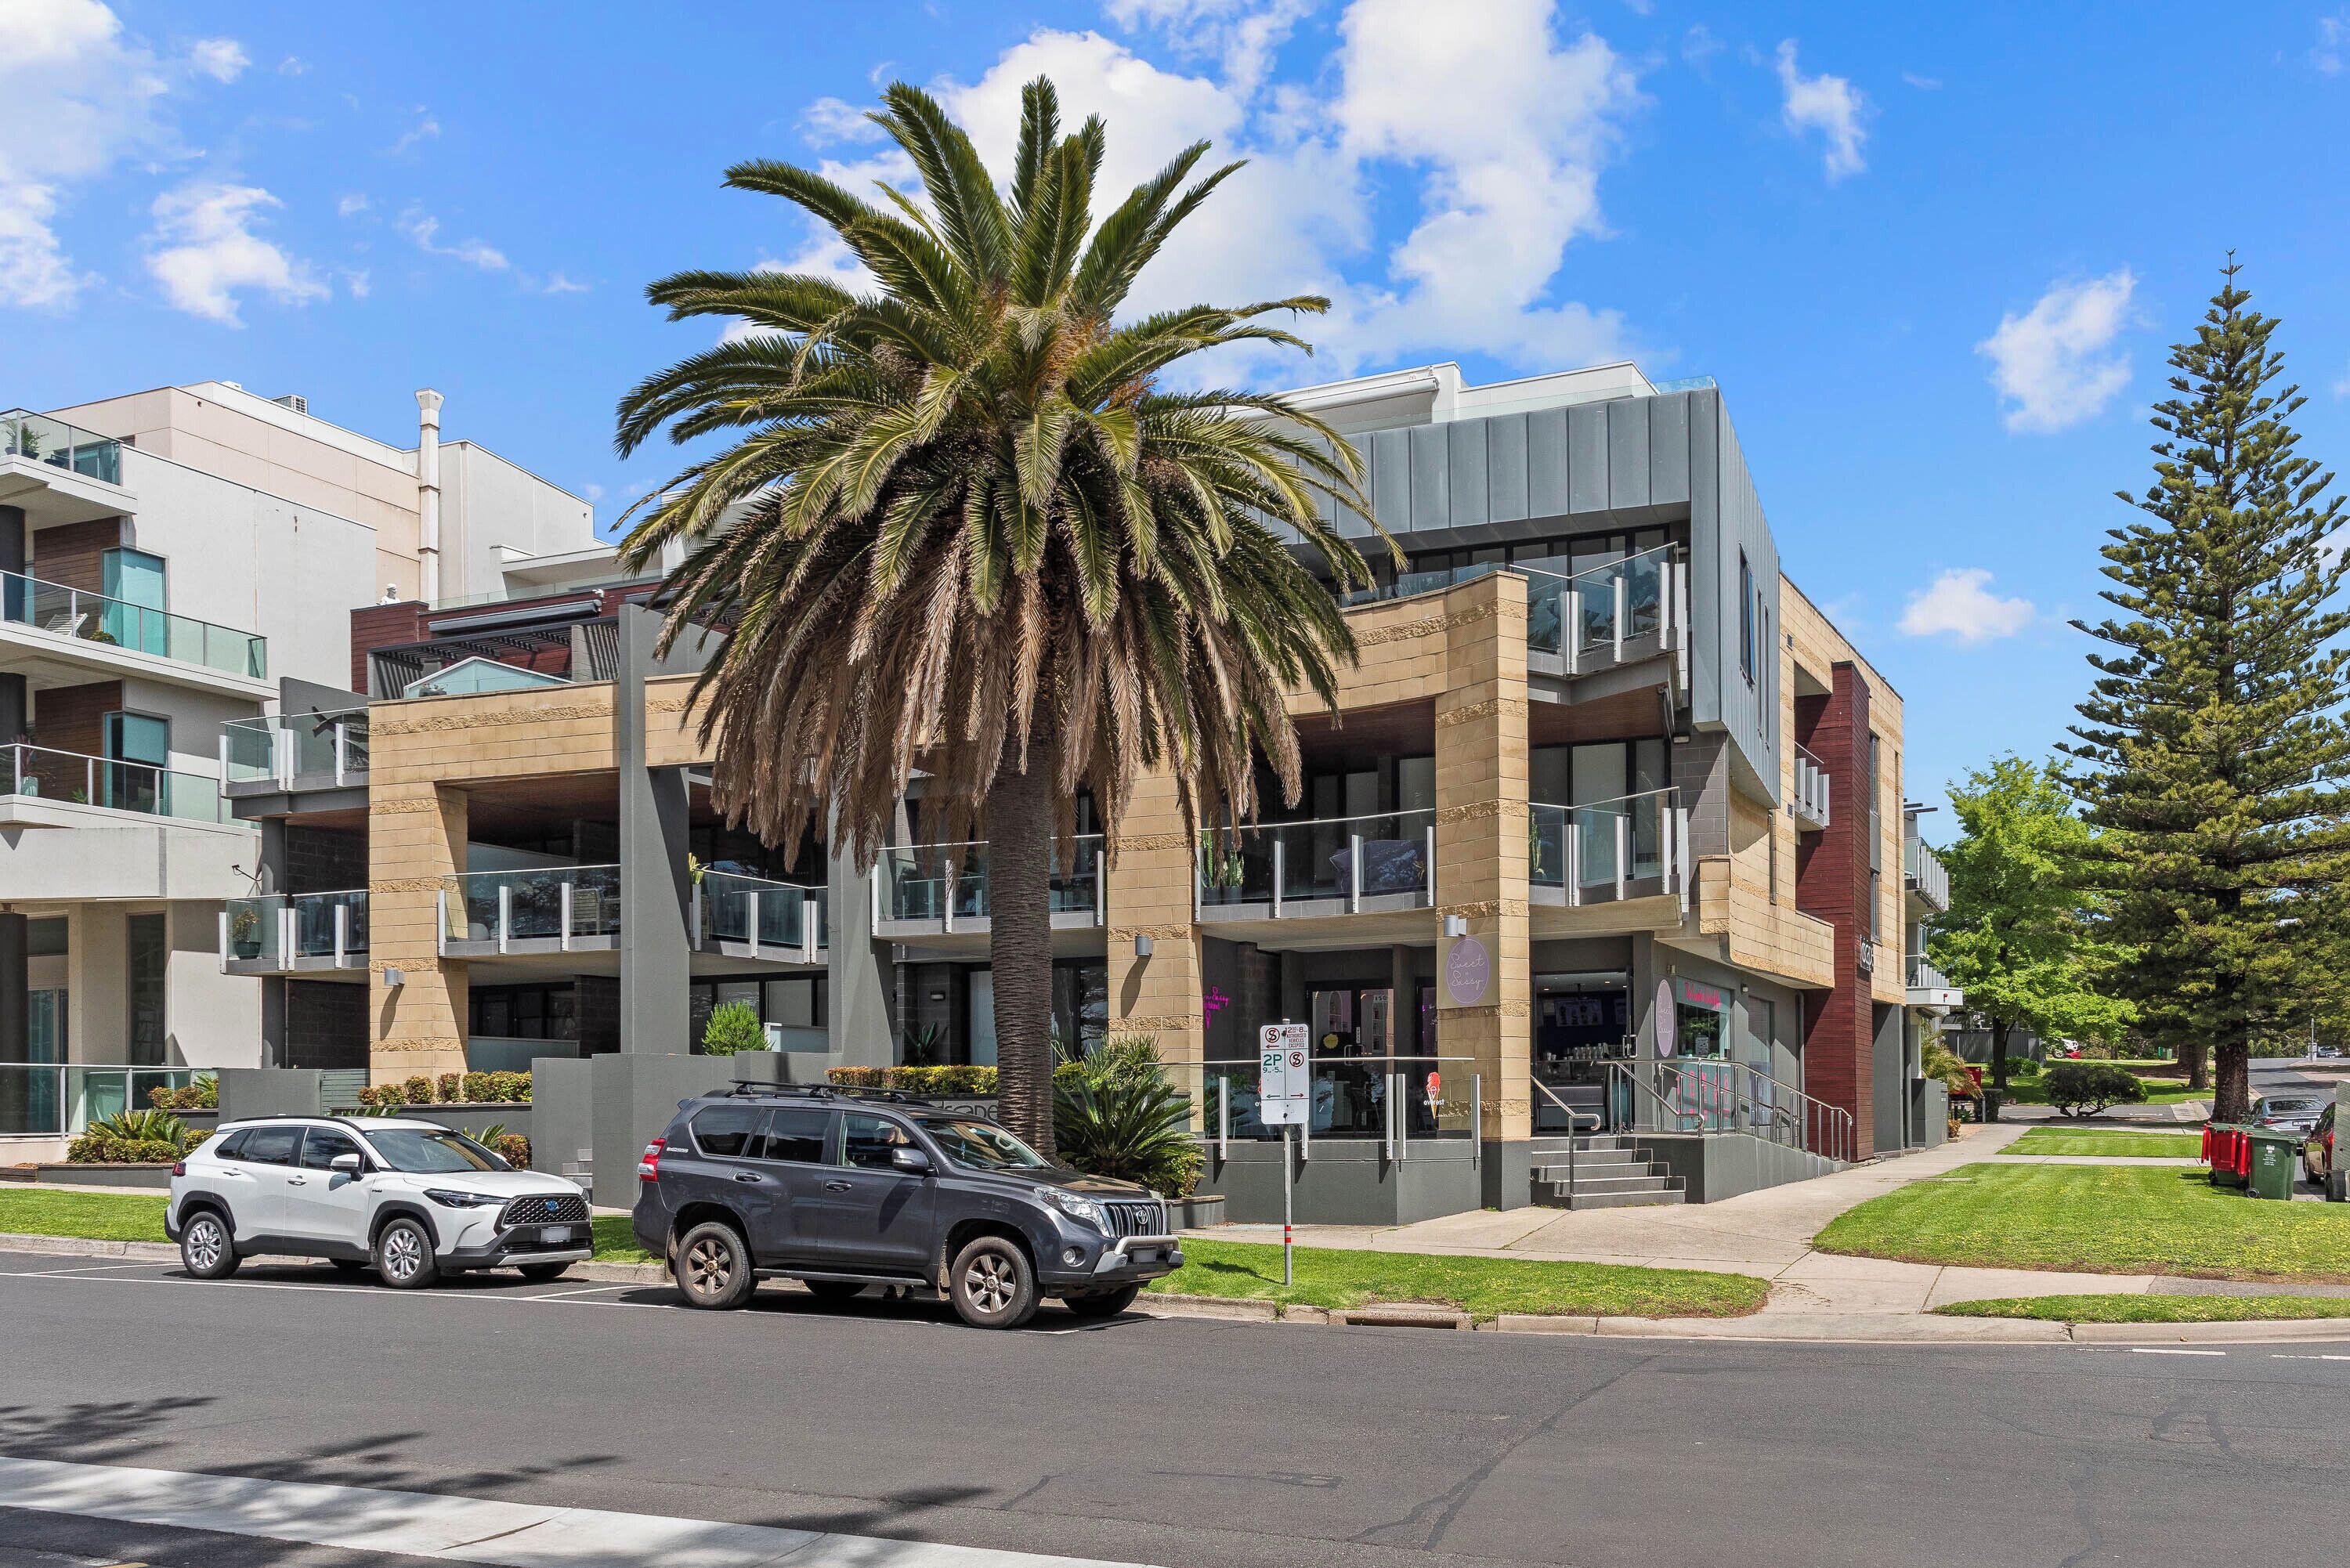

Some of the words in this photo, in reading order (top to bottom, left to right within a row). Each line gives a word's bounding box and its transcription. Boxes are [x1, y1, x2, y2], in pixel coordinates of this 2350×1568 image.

[1451, 953, 1485, 969] Sweet
[1452, 970, 1484, 991] Sassy
[1263, 1054, 1282, 1066] 2P
